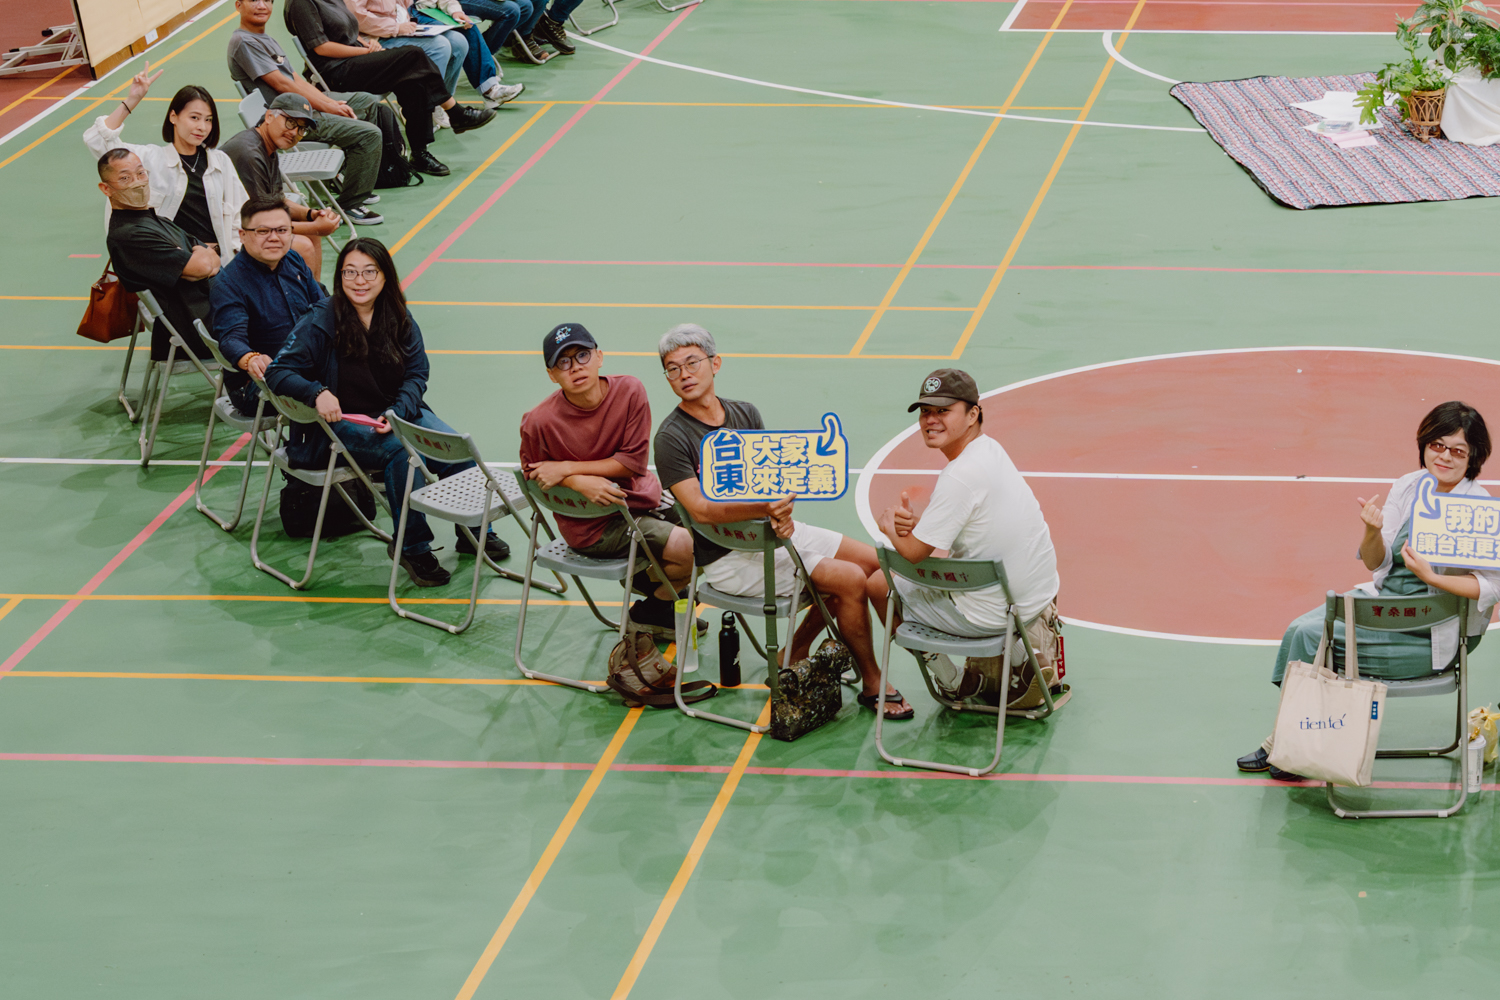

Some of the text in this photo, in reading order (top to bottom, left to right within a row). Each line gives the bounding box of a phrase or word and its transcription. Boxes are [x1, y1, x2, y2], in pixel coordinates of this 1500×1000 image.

[712, 430, 747, 496] 台東
[752, 435, 810, 466] 大家
[751, 464, 837, 496] 來定義
[1371, 603, 1433, 619] 寶桑國中
